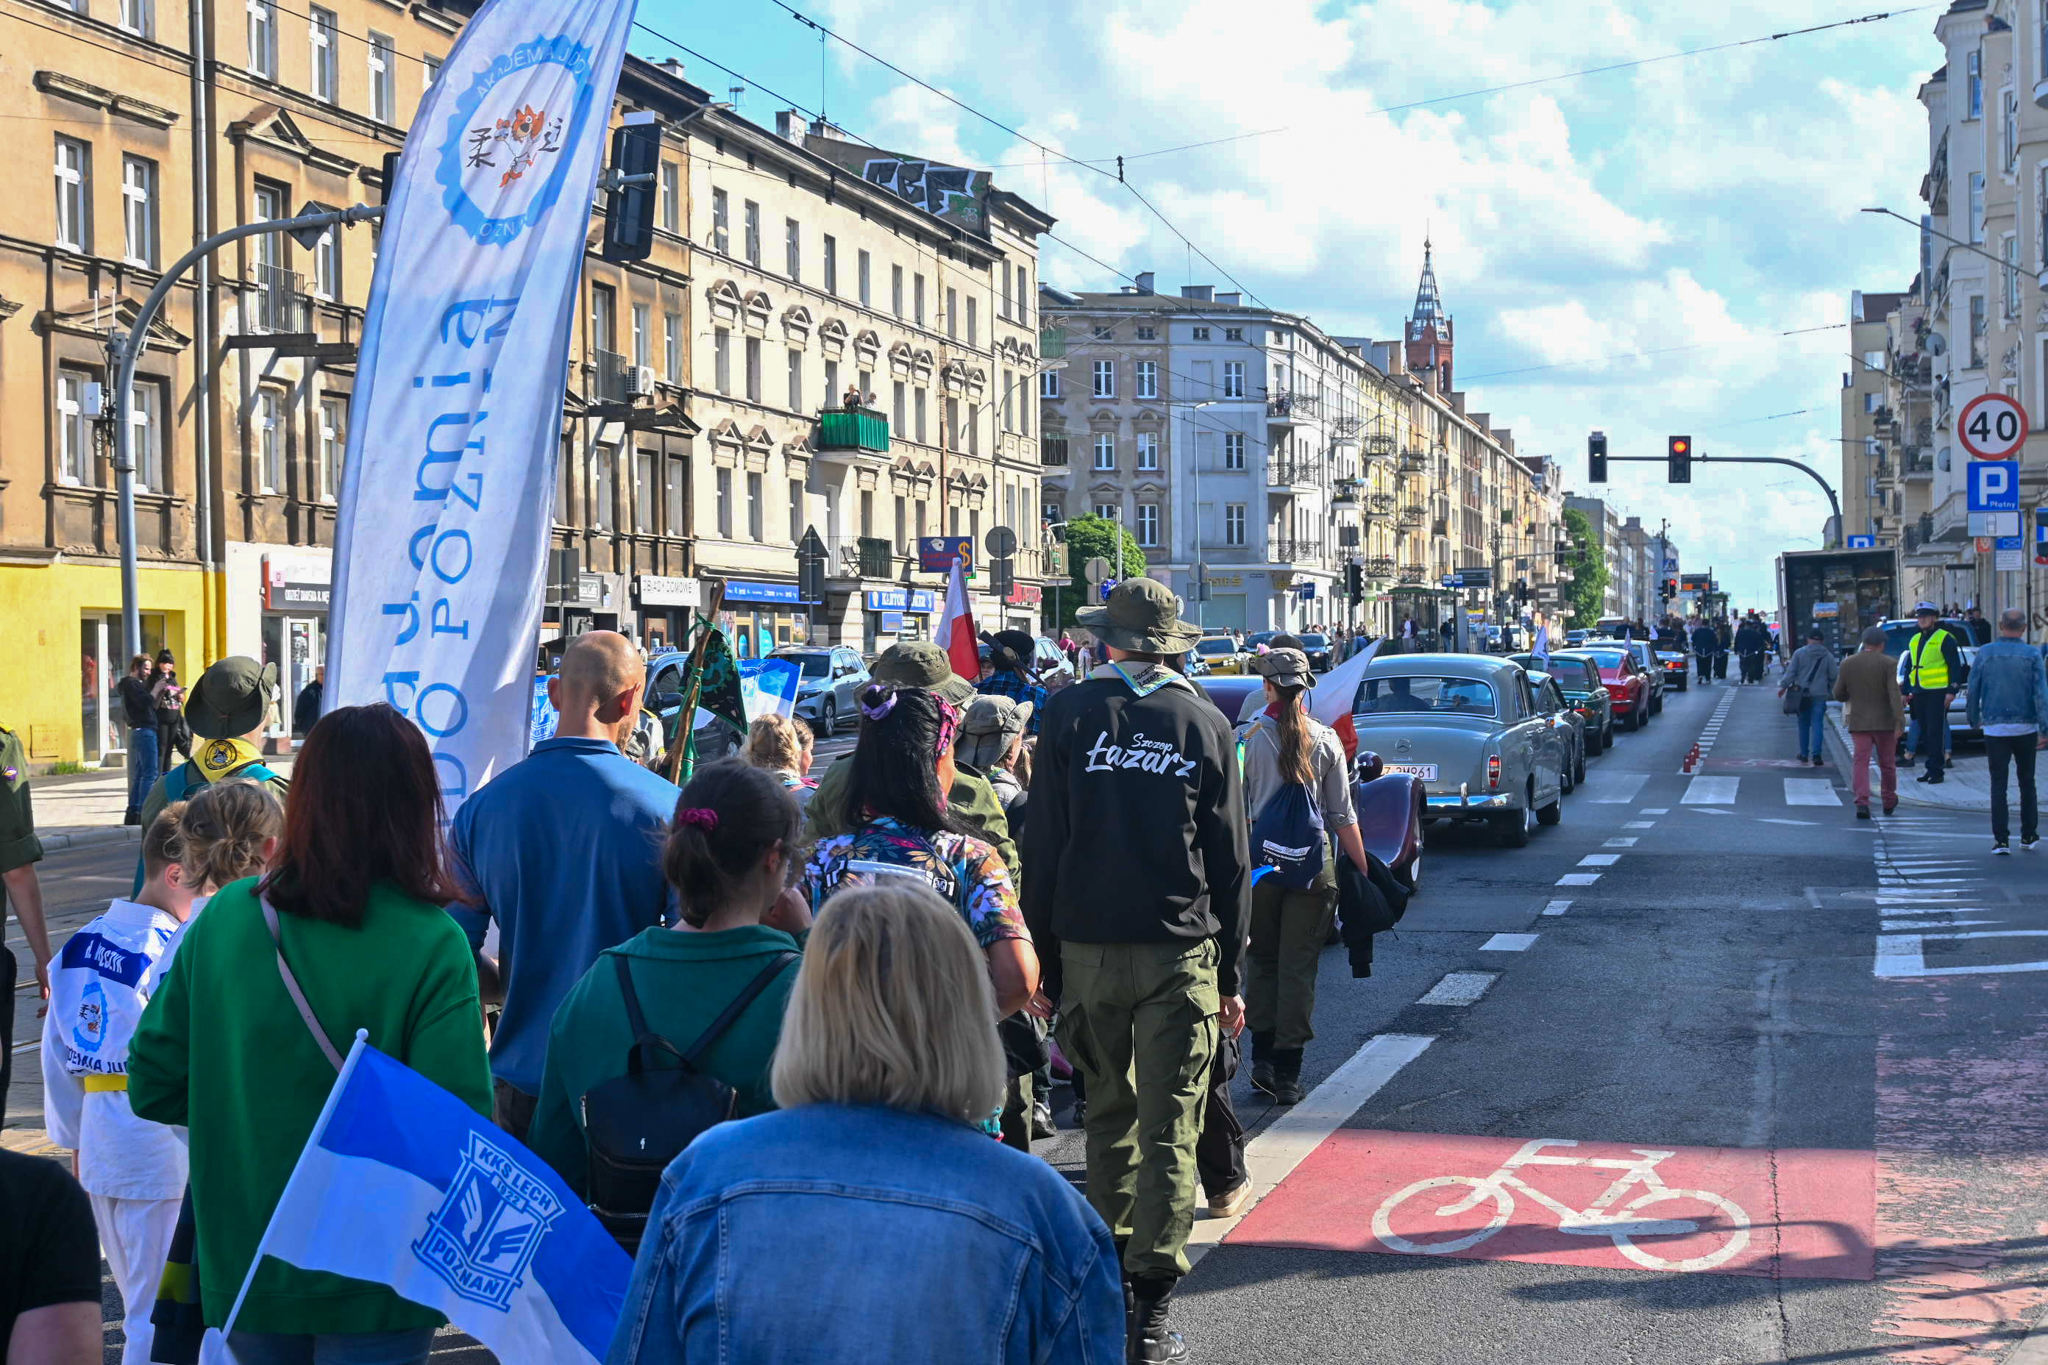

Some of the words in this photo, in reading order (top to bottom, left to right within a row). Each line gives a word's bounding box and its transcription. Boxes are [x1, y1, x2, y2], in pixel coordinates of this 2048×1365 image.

[1968, 411, 2018, 442] 40
[1979, 466, 2008, 506] P
[1989, 500, 2016, 509] Płatny
[1085, 731, 1197, 778] Łazarz
[1132, 732, 1173, 756] Szczep
[479, 1147, 512, 1179] KKS
[511, 1173, 552, 1211] LECH
[496, 1180, 520, 1206] 1922
